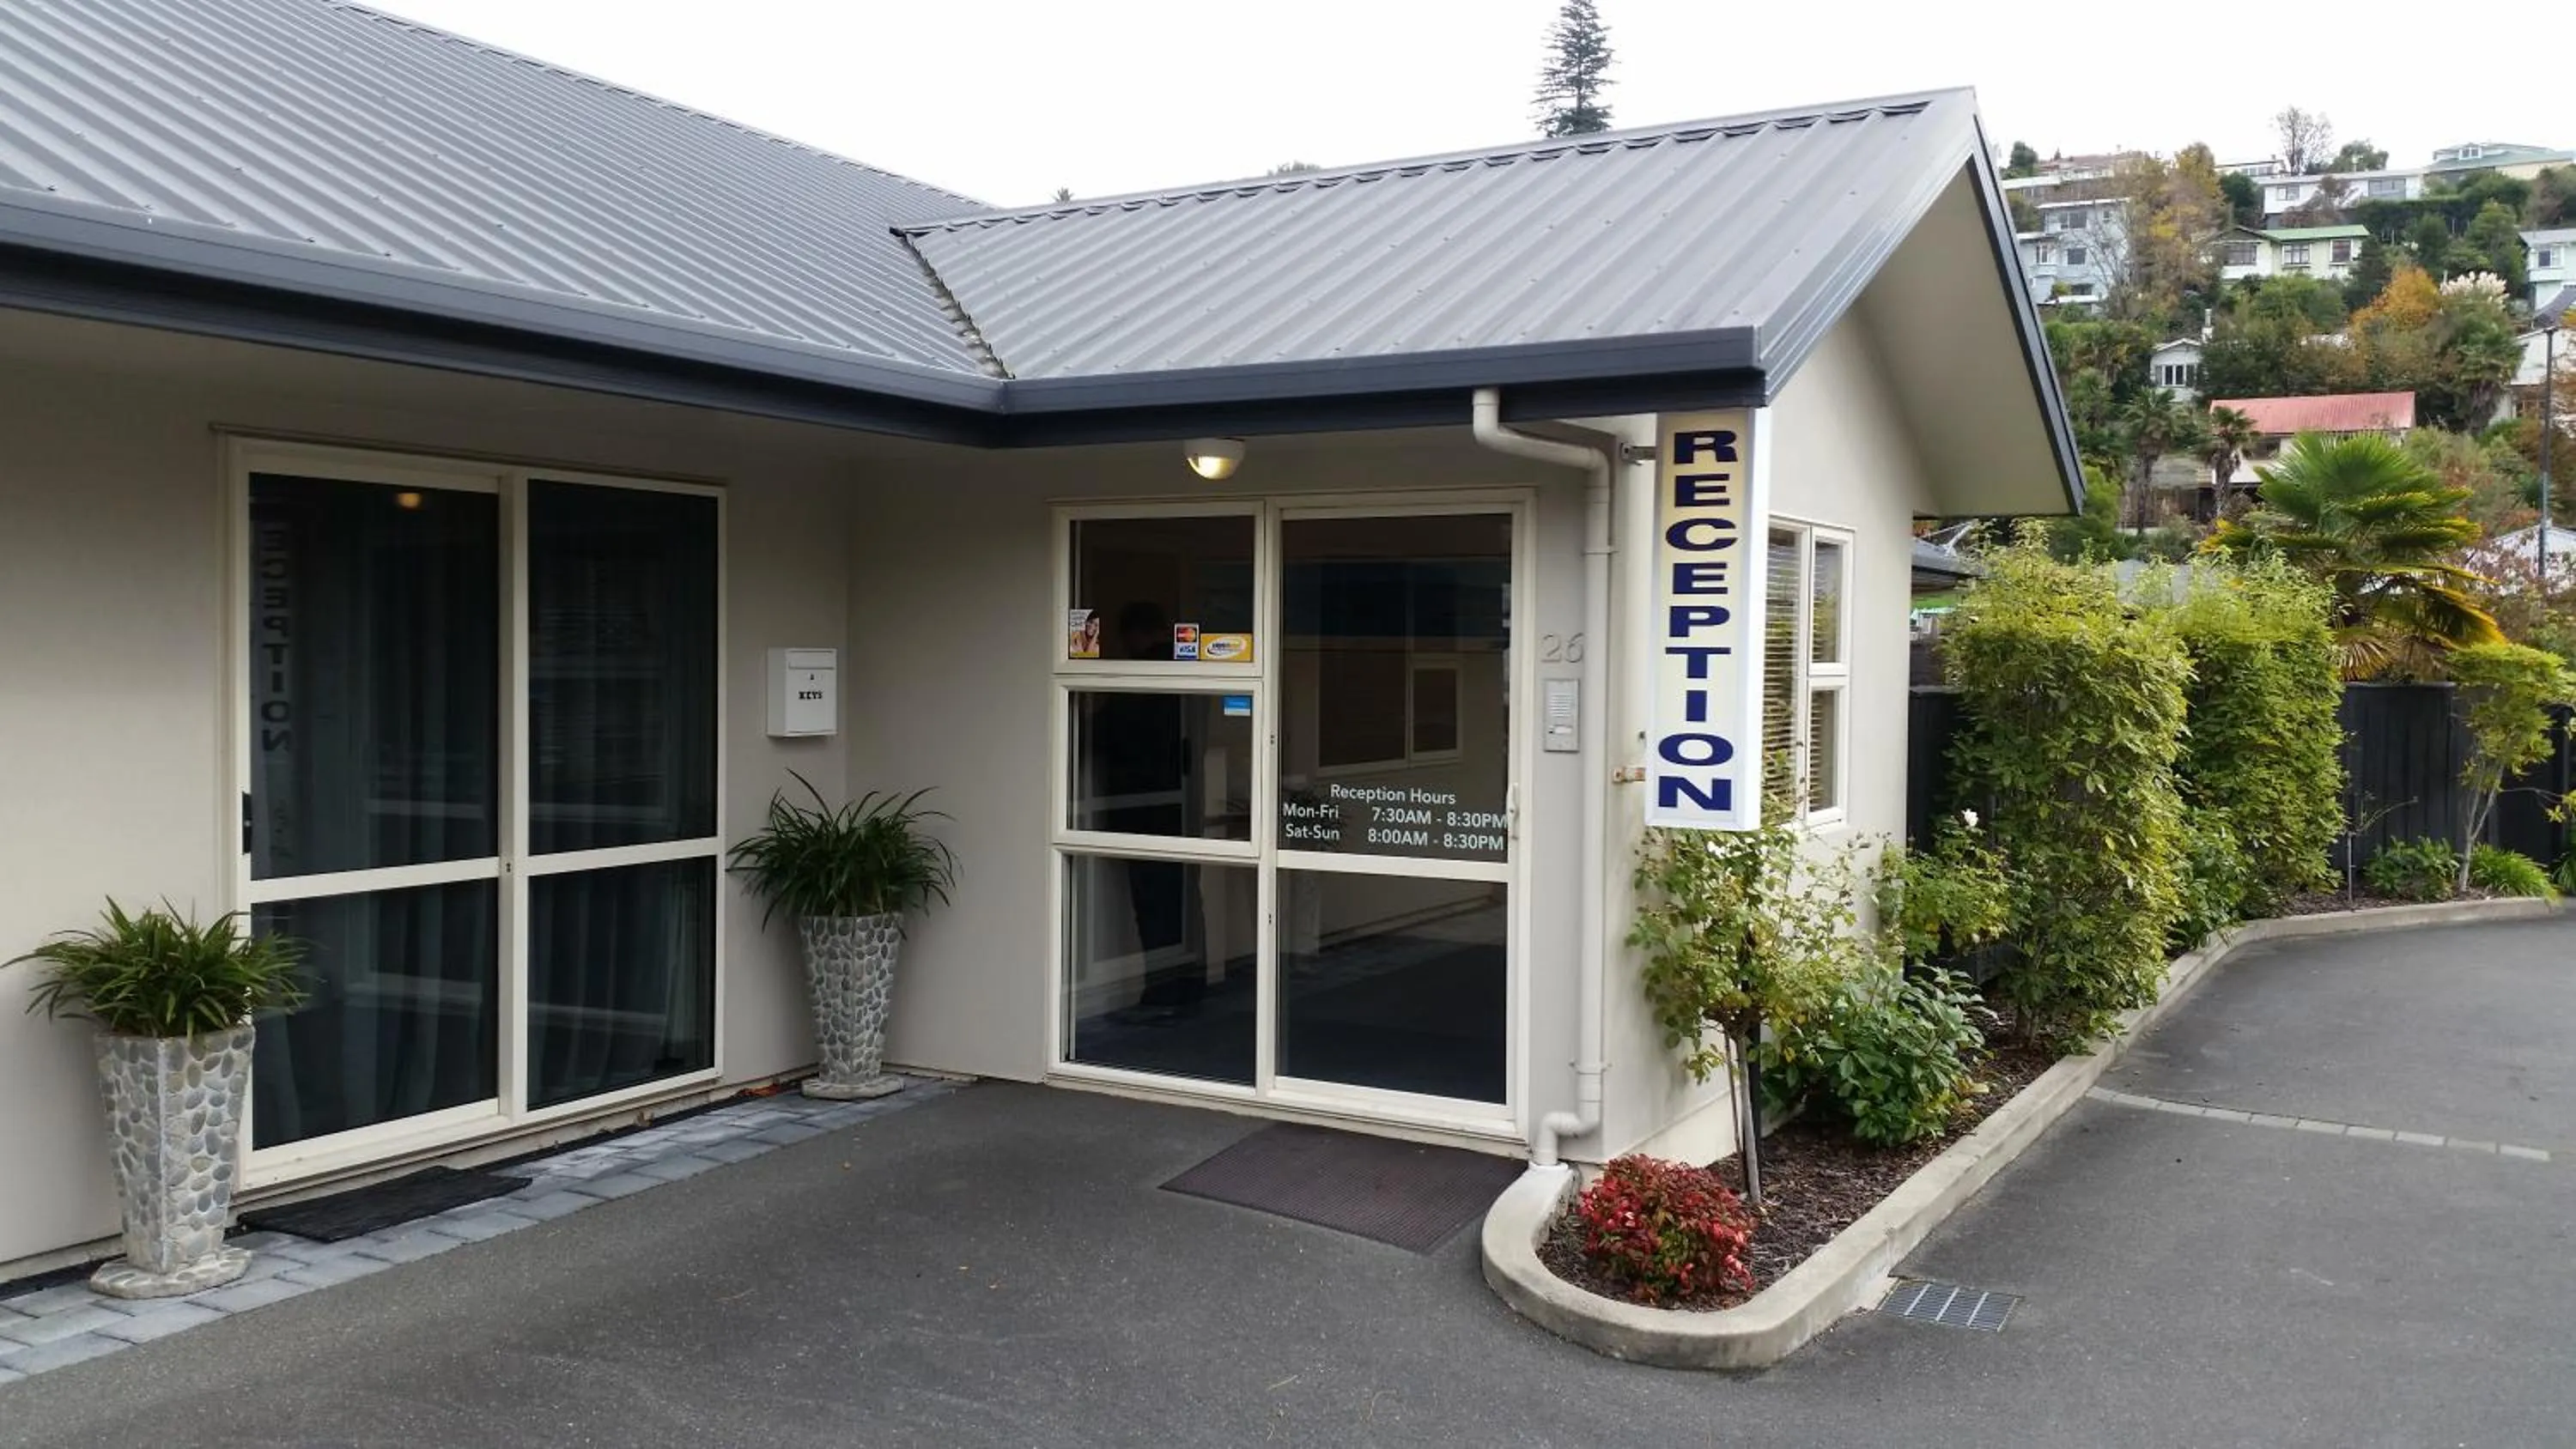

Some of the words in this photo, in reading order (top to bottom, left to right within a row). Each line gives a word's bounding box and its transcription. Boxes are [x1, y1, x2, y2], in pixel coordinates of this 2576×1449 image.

[1658, 430, 1739, 811] RECEPTION
[1541, 633, 1583, 663] 26
[799, 691, 823, 700] KEYS
[1331, 784, 1406, 803] Reception
[1411, 788, 1456, 804] Hours
[1283, 803, 1340, 819] Mon-Fri
[1372, 806, 1431, 825] 7:30AM
[1447, 812, 1509, 829] 8:30PM
[1285, 824, 1340, 840] Sat-Sun
[1368, 828, 1428, 846] 8:00AM
[1443, 834, 1504, 851] 8:30PM
